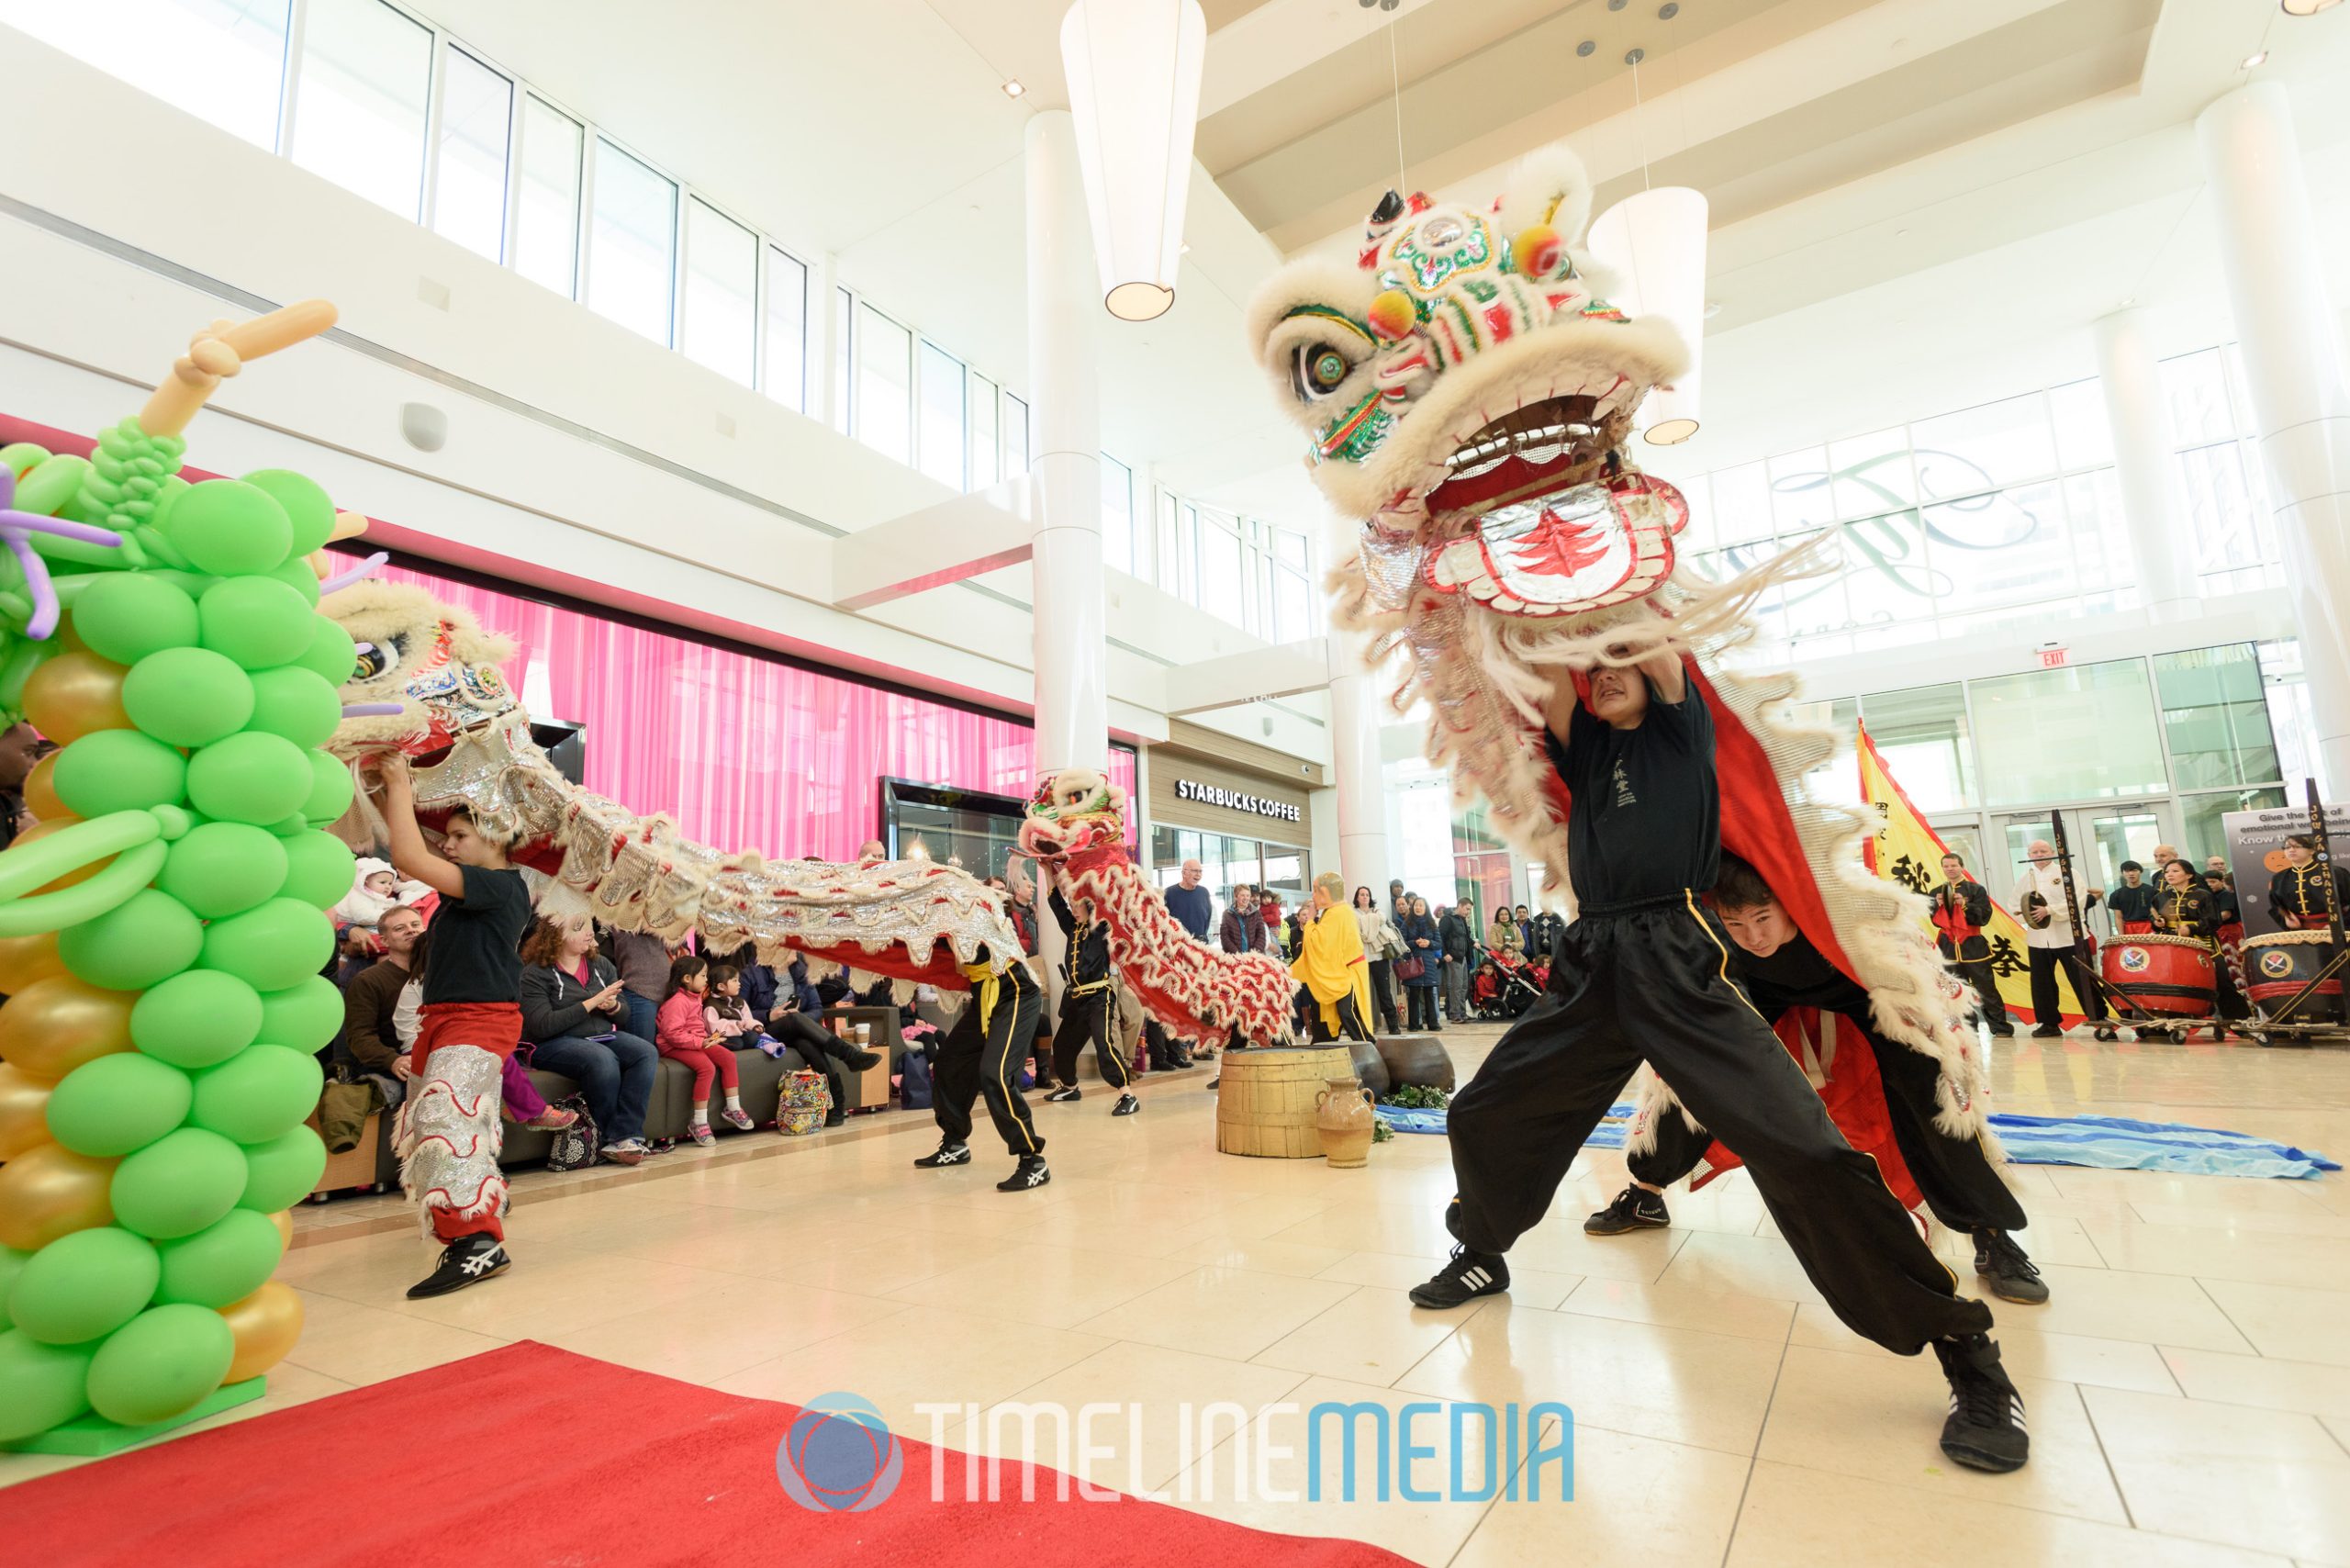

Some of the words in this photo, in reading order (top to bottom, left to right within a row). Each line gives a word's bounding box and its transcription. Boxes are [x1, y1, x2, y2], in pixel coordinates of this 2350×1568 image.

[2043, 652, 2065, 666] EXIT
[1176, 778, 1258, 813] STARBUCKS
[1258, 798, 1301, 822] COFFEE
[2259, 813, 2284, 822] Give
[2287, 812, 2305, 820] the
[2330, 808, 2344, 816] of
[2311, 805, 2322, 830] JOW
[2240, 823, 2295, 834] emotional
[2238, 836, 2275, 846] Know
[2314, 834, 2326, 852] GA
[2056, 834, 2065, 855] JOW
[2065, 885, 2080, 937] SHAOLIN
[2321, 862, 2338, 923] SHAOLIN
